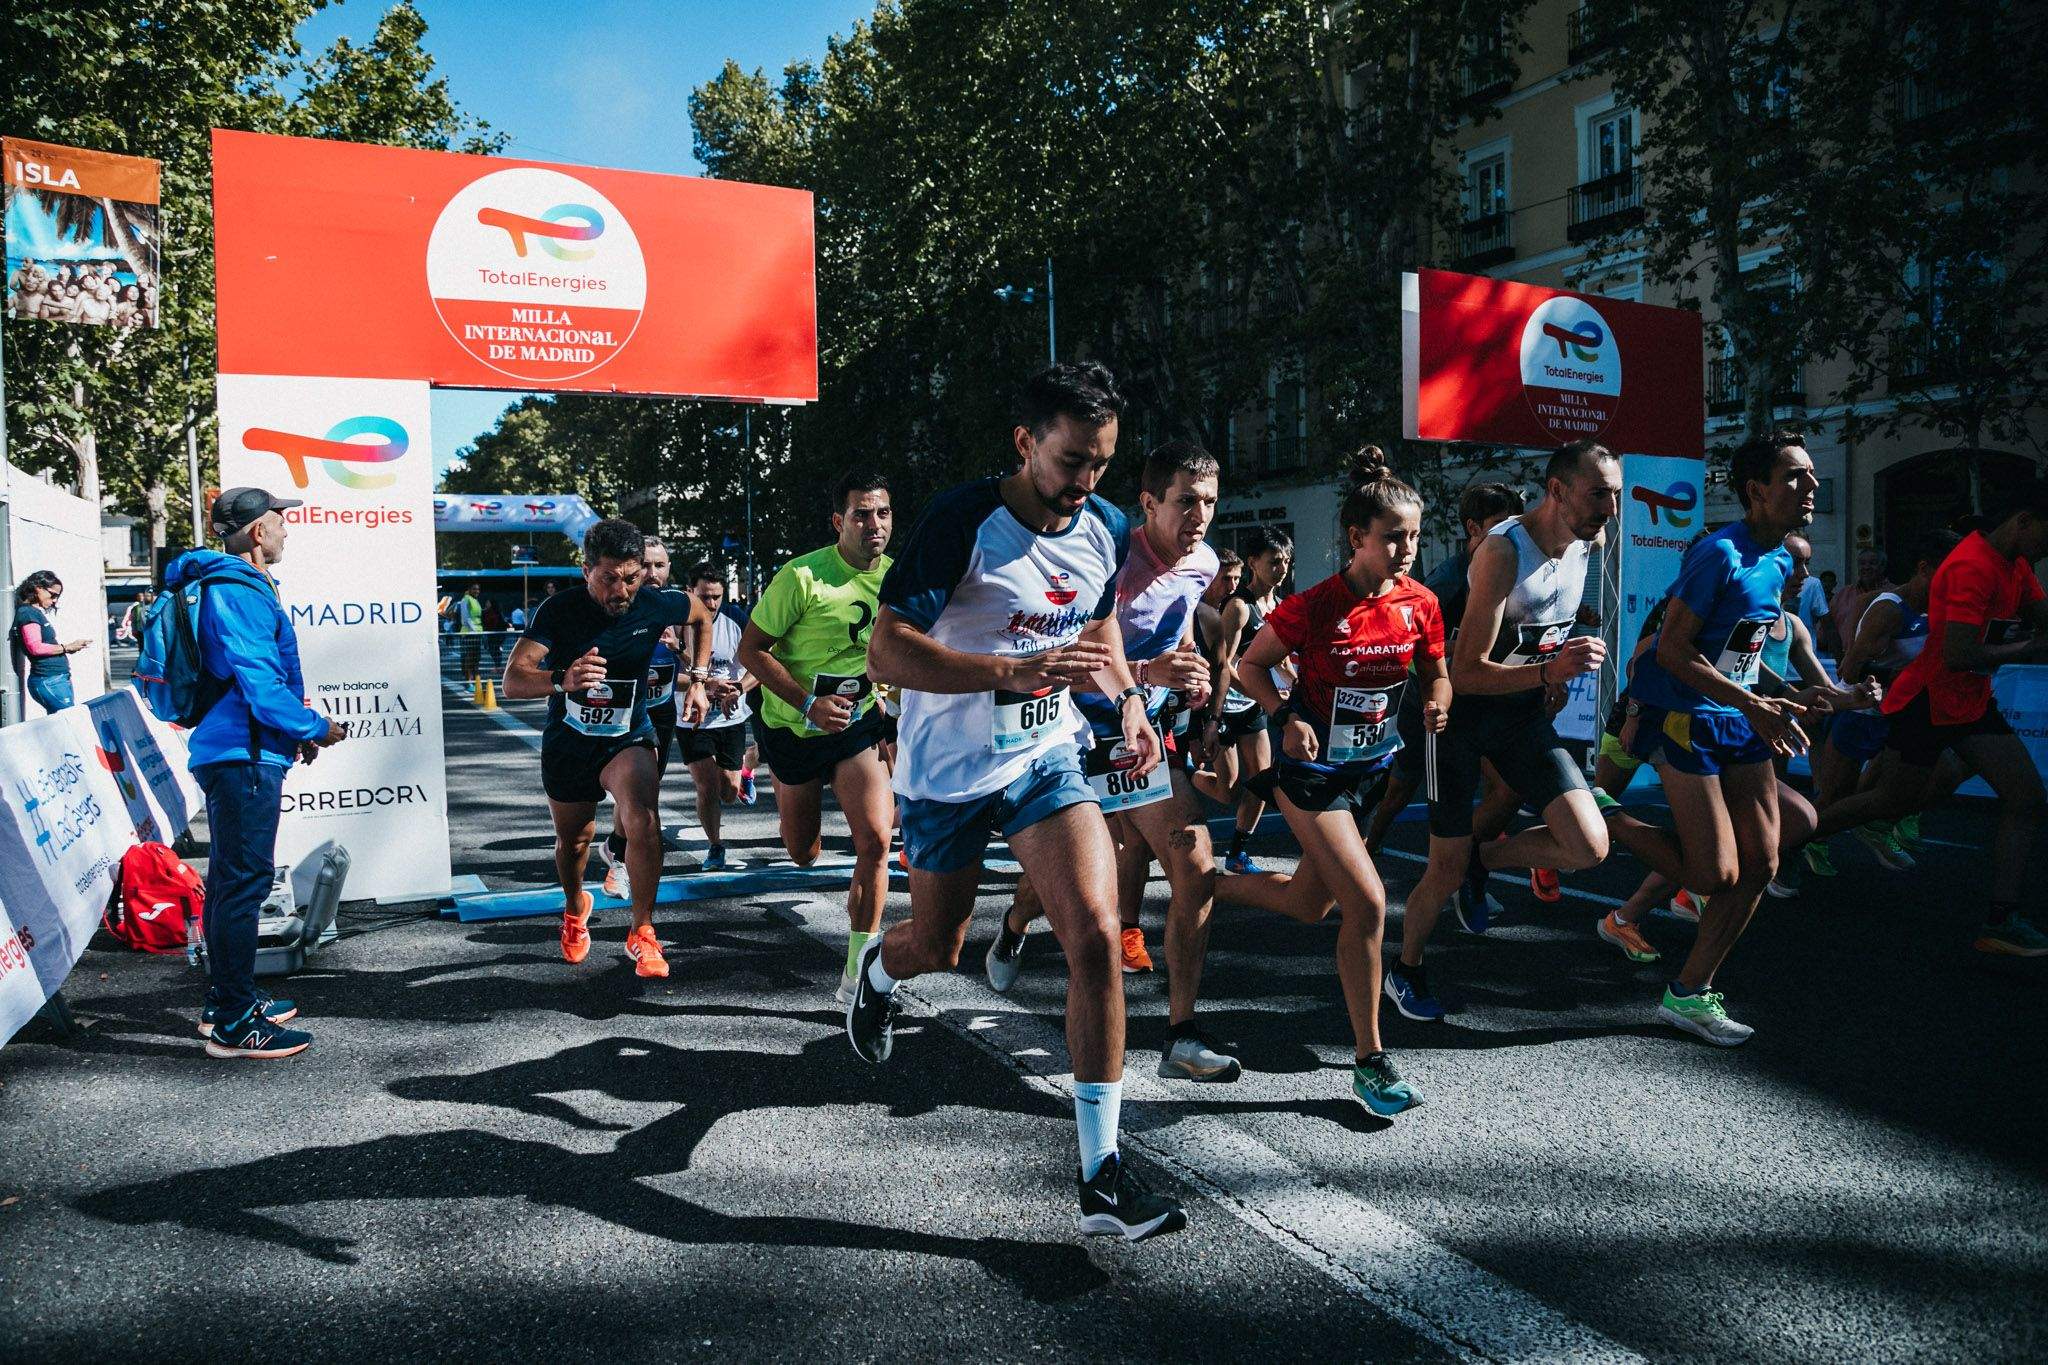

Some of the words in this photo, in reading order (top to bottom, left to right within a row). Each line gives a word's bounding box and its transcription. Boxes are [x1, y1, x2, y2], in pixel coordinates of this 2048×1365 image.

[15, 161, 81, 190] ISLA
[479, 269, 607, 293] TotalEnergies
[511, 308, 573, 326] MILLA
[488, 344, 517, 360] DE
[520, 346, 596, 364] MADRID
[1544, 364, 1605, 384] TotalEnergies
[1559, 393, 1589, 405] MILLA
[1549, 417, 1565, 430] DE
[1567, 419, 1599, 433] MADRID
[285, 505, 413, 529] alEnergies
[290, 602, 422, 626] MADRID
[318, 683, 340, 692] new
[343, 681, 389, 691] balance
[321, 693, 409, 715] MILLA
[1020, 694, 1060, 730] 605
[580, 707, 615, 725] 592
[347, 716, 424, 739] RBANA
